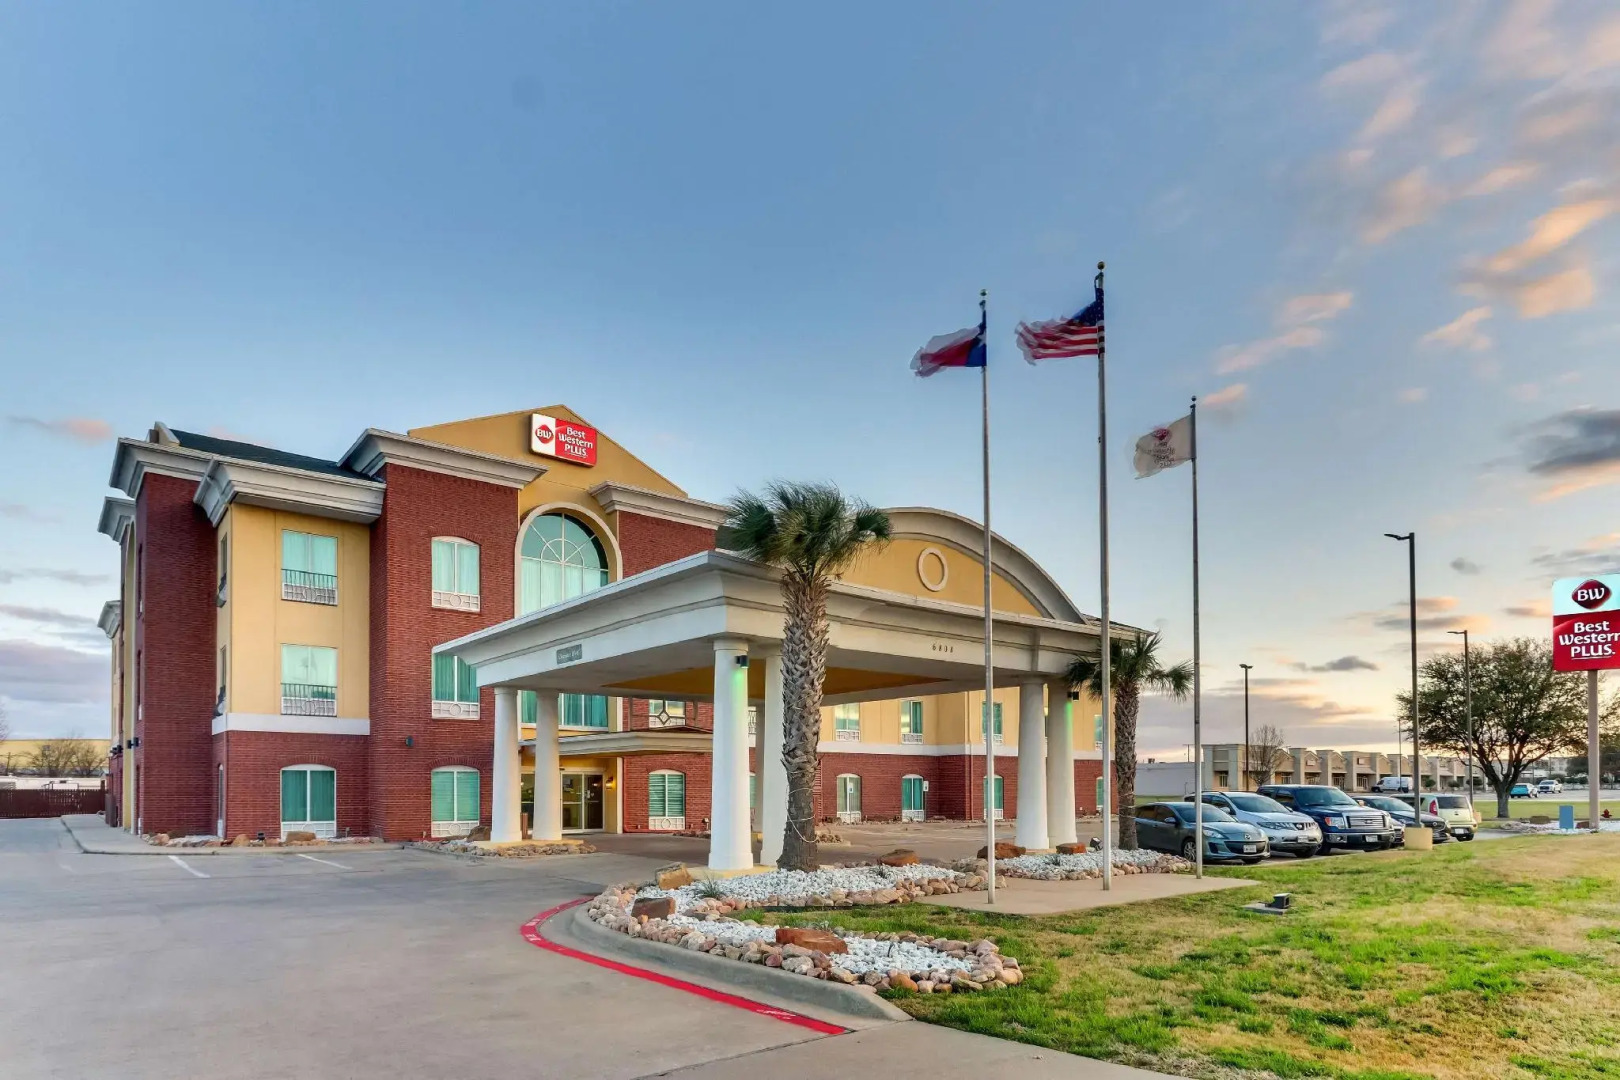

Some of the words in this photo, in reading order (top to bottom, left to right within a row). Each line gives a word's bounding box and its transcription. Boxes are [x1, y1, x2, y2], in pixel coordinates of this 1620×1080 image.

[536, 428, 552, 440] BW
[566, 427, 585, 439] Best
[558, 433, 593, 449] Western
[564, 444, 587, 456] PLUS
[1577, 588, 1605, 602] BW
[1574, 620, 1610, 634] Best
[1570, 643, 1612, 658] PLUS
